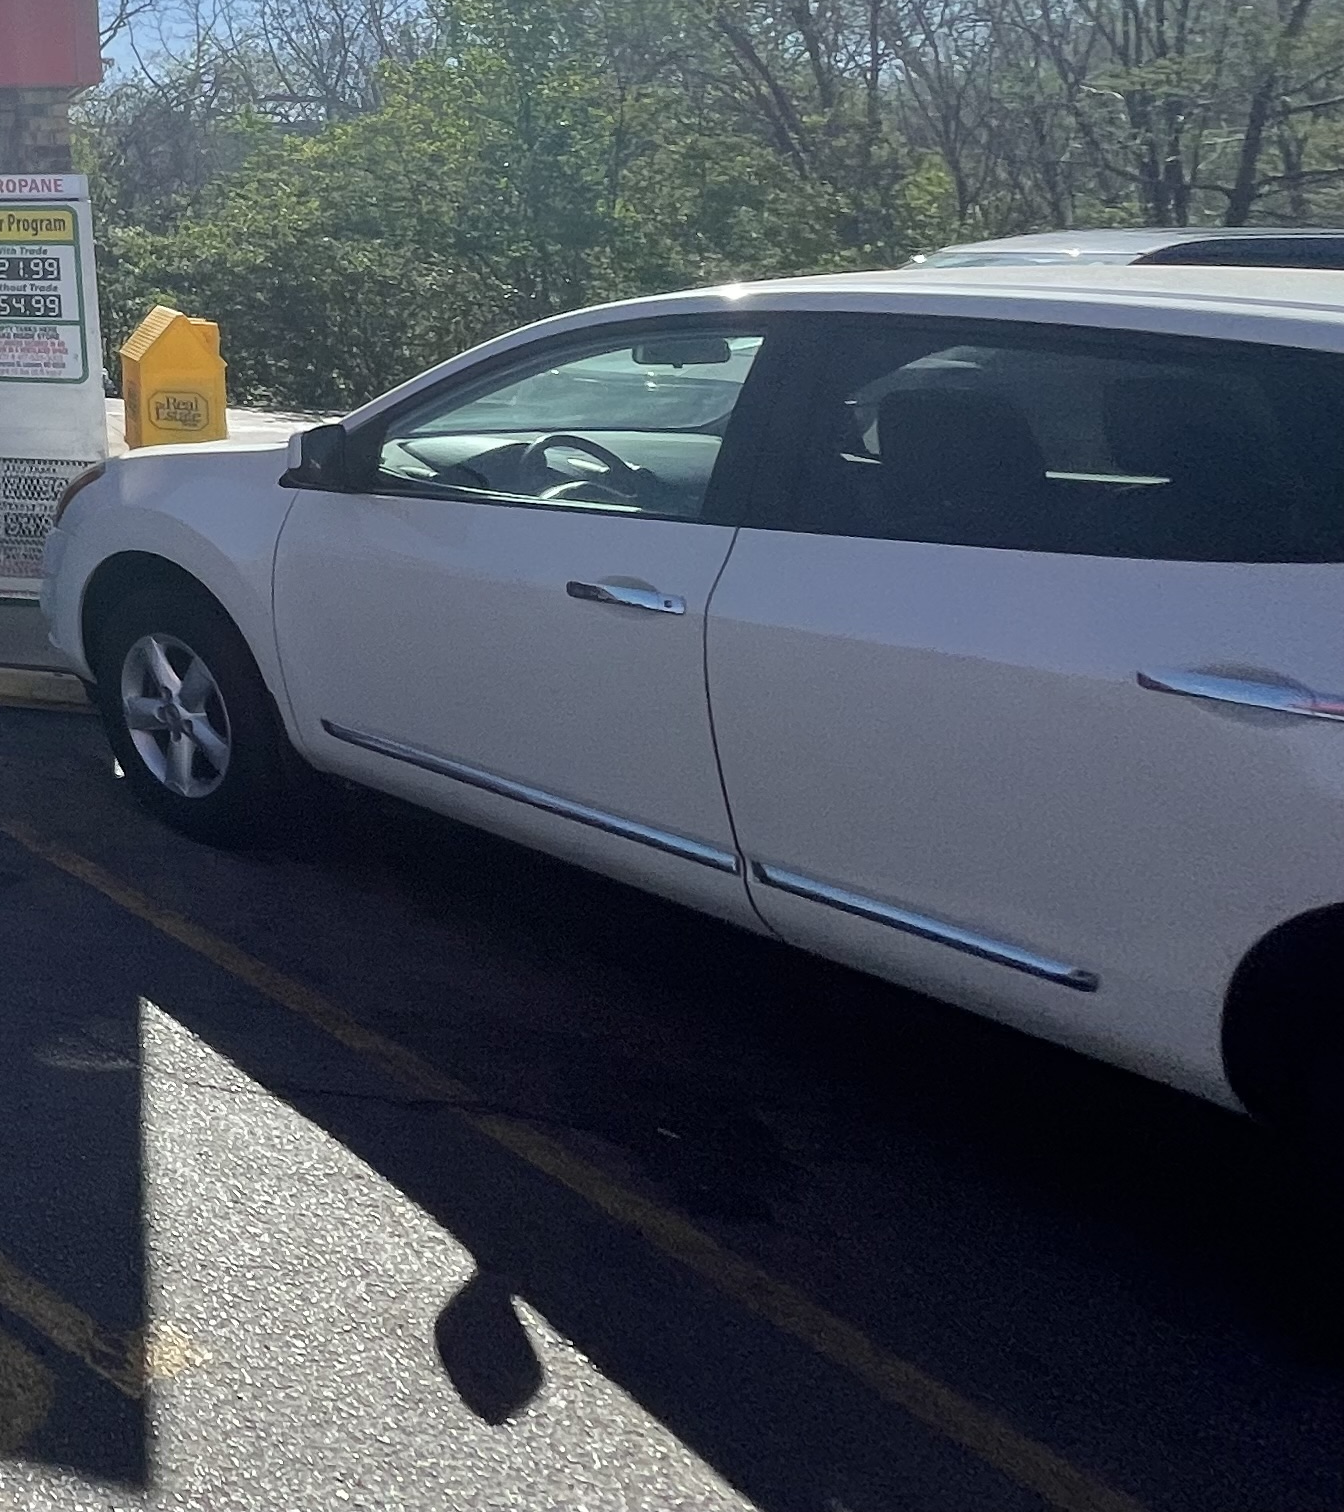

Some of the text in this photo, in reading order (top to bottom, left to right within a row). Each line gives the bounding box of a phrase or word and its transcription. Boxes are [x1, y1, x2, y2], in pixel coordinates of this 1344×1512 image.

[7, 214, 66, 236] Program
[19, 246, 48, 256] Trade
[30, 283, 58, 292] Trade
[165, 395, 198, 410] Real
[156, 405, 202, 422] Estate
